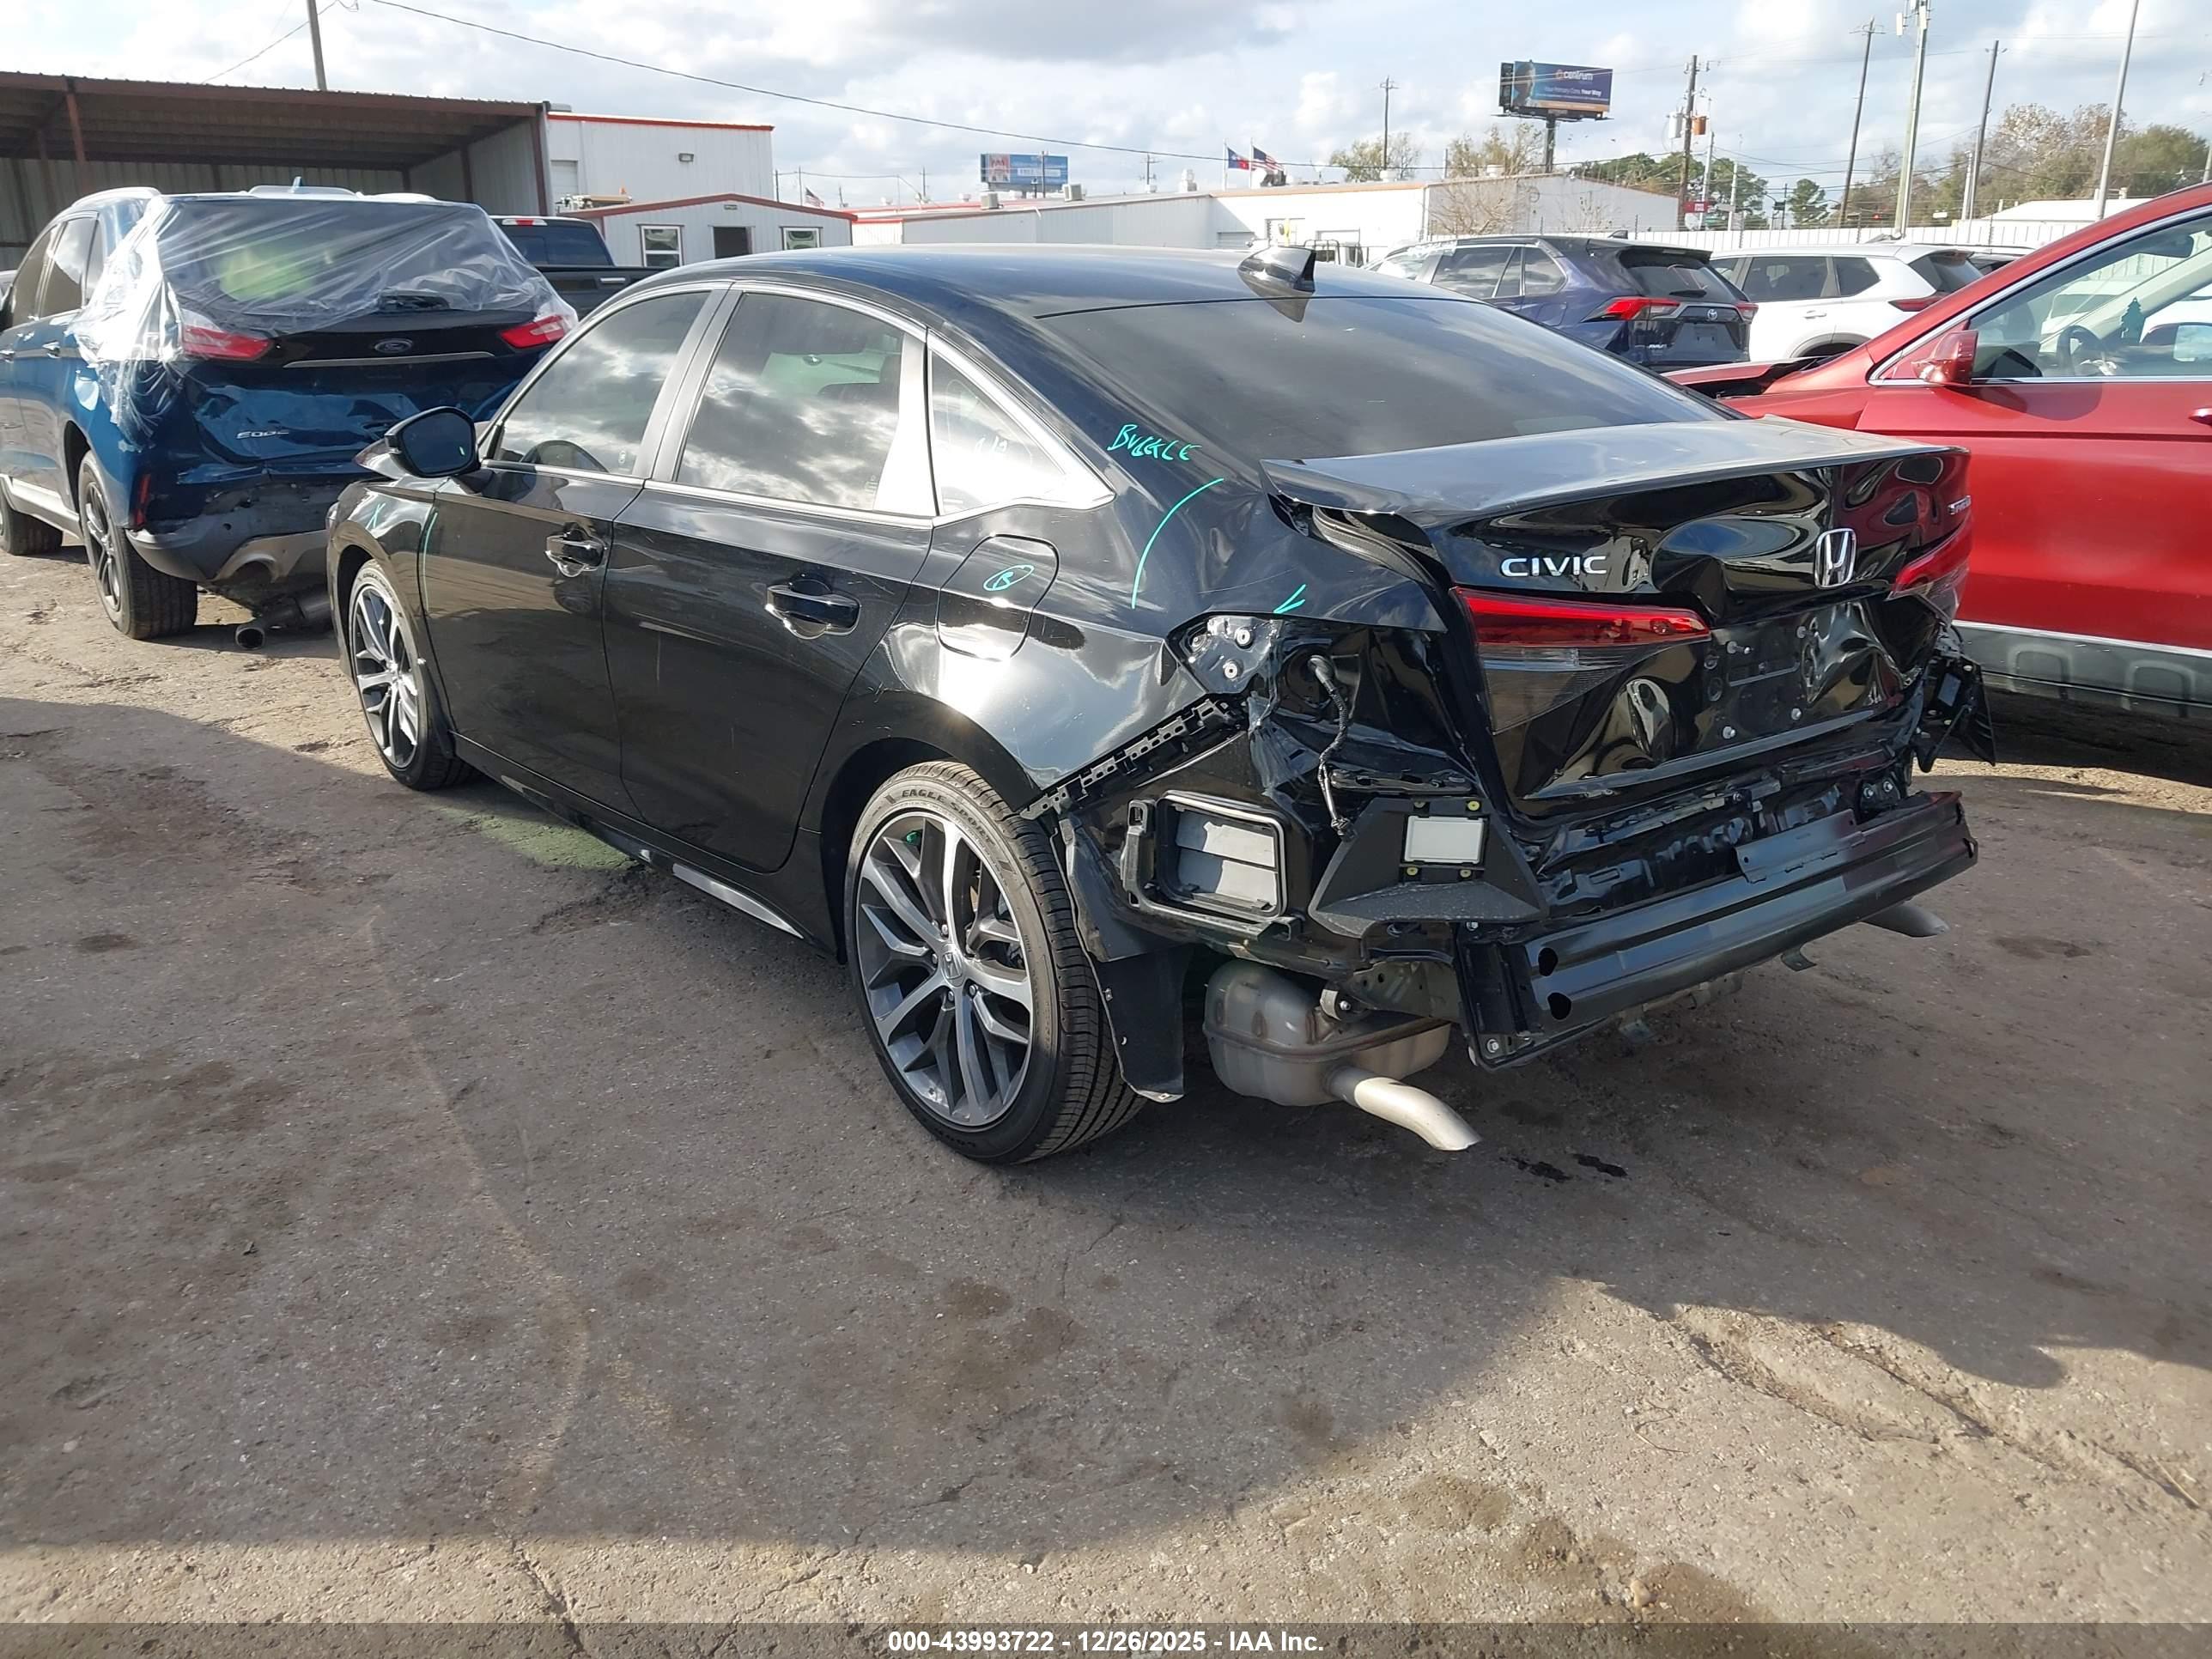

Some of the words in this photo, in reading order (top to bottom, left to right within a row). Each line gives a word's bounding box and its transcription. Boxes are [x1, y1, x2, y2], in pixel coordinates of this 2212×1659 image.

[1501, 556, 1607, 577] CIVIC
[902, 788, 946, 804] EAGLE
[949, 801, 996, 845] SPORT
